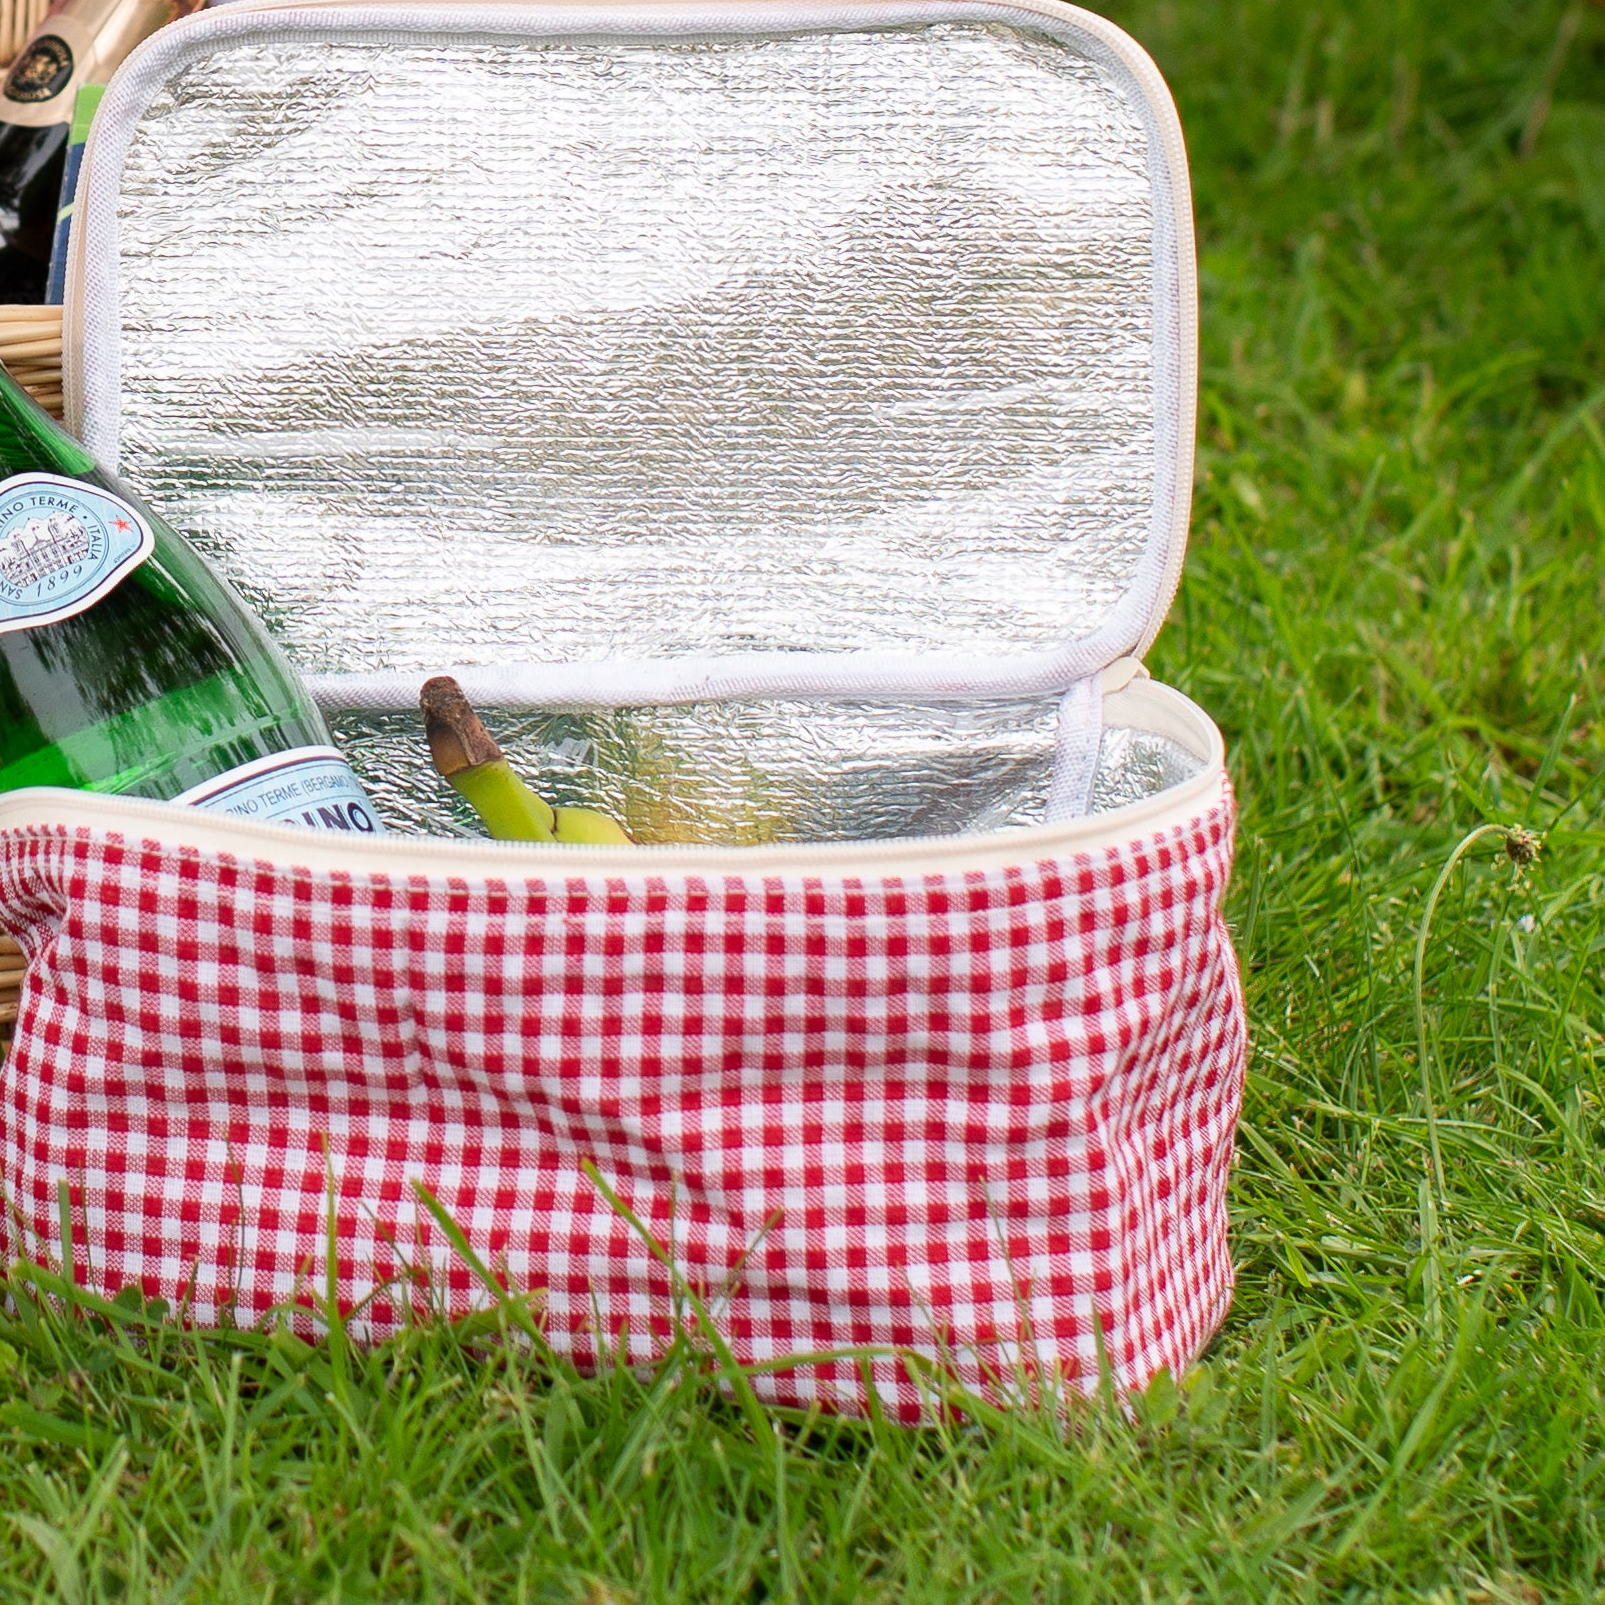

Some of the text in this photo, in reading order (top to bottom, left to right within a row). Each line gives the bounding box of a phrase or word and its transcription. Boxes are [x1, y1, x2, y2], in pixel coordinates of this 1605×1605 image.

[30, 496, 79, 513] TERME
[87, 525, 103, 560] ITALIA
[37, 564, 83, 598] 1899
[258, 782, 303, 807] TERME
